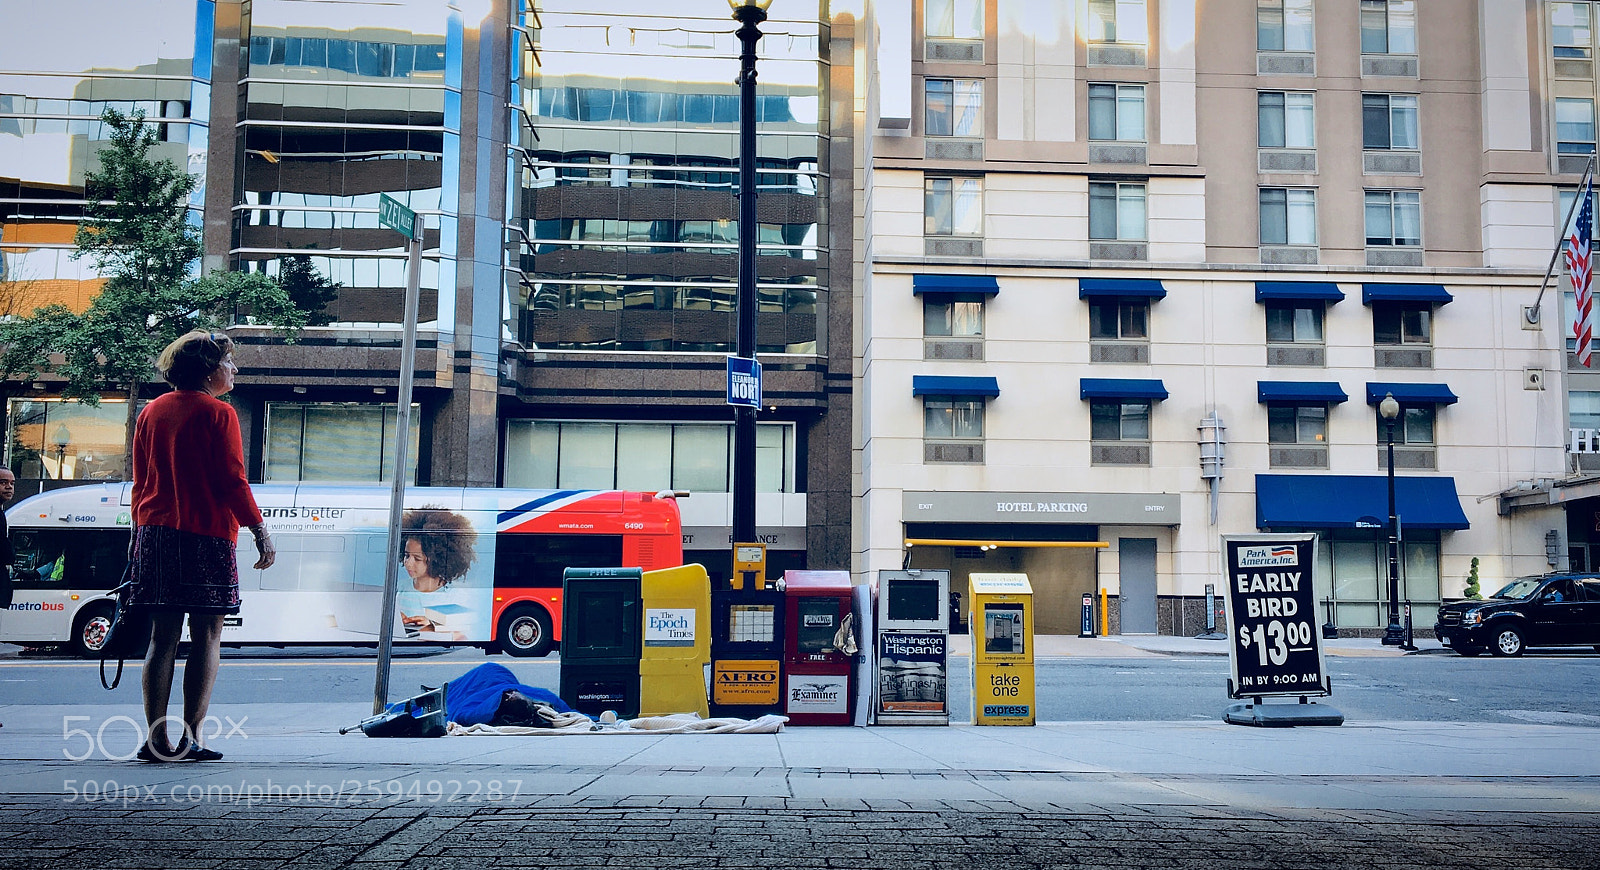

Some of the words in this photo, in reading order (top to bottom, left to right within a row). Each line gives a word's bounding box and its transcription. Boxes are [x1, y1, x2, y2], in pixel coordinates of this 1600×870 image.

[301, 507, 346, 518] better
[997, 502, 1035, 512] HOTEL
[1037, 502, 1088, 513] PARKING
[624, 522, 644, 530] 6490
[1246, 549, 1267, 558] Park
[589, 568, 618, 577] FREE
[1236, 572, 1302, 593] EARLY
[1246, 597, 1298, 618] BIRD
[660, 611, 674, 619] The
[649, 615, 688, 631] Epoch
[667, 629, 694, 638] Times
[883, 634, 943, 646] Washington
[885, 643, 943, 656] Hispanic
[717, 672, 777, 682] AFRO
[990, 672, 1021, 687] take
[1242, 676, 1253, 686] IN
[1257, 676, 1269, 685] BY
[1273, 674, 1298, 684] 9:00
[1301, 672, 1318, 683] AM
[791, 688, 838, 702] Examiner
[992, 686, 1019, 697] one
[984, 706, 1028, 716] express
